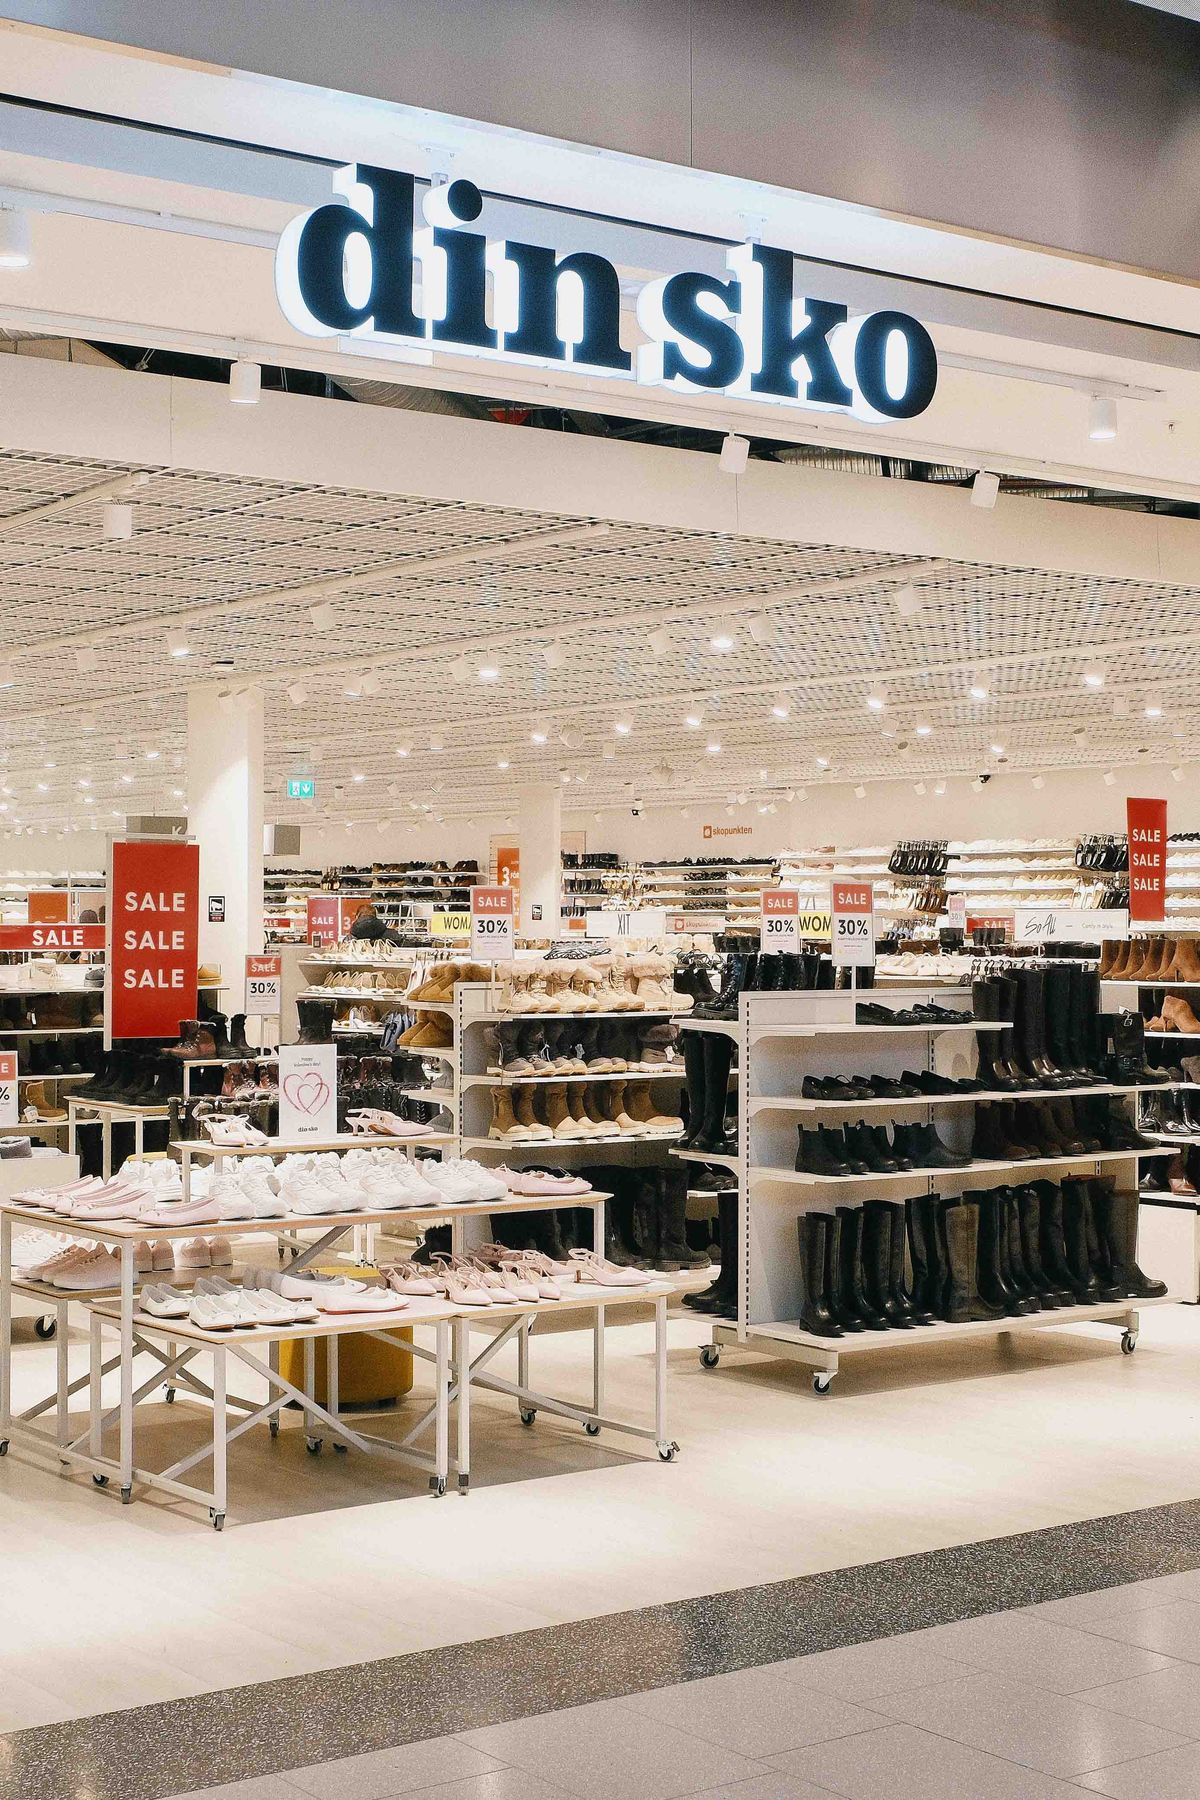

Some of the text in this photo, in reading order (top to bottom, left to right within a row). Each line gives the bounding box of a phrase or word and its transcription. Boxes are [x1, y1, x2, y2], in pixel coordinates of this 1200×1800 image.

[297, 163, 938, 419] din sko
[712, 825, 753, 837] skopunkten
[1132, 829, 1161, 843] SALE
[1132, 853, 1160, 867] SALE
[1133, 878, 1160, 891] SALE
[124, 891, 186, 912] SALE
[478, 896, 507, 907] SALE
[767, 898, 793, 909] SALE
[837, 892, 867, 905] SALE
[311, 916, 334, 925] SALE
[443, 916, 472, 930] WOM
[477, 919, 508, 934] 30%
[617, 913, 631, 935] XIT
[767, 920, 794, 932] 30%
[799, 915, 832, 932] WOM
[838, 919, 868, 935] 30%
[31, 929, 84, 946] SALE
[123, 930, 185, 950] SALE
[251, 963, 276, 973] SALE
[123, 968, 184, 989] SALE
[250, 982, 277, 994] 30%
